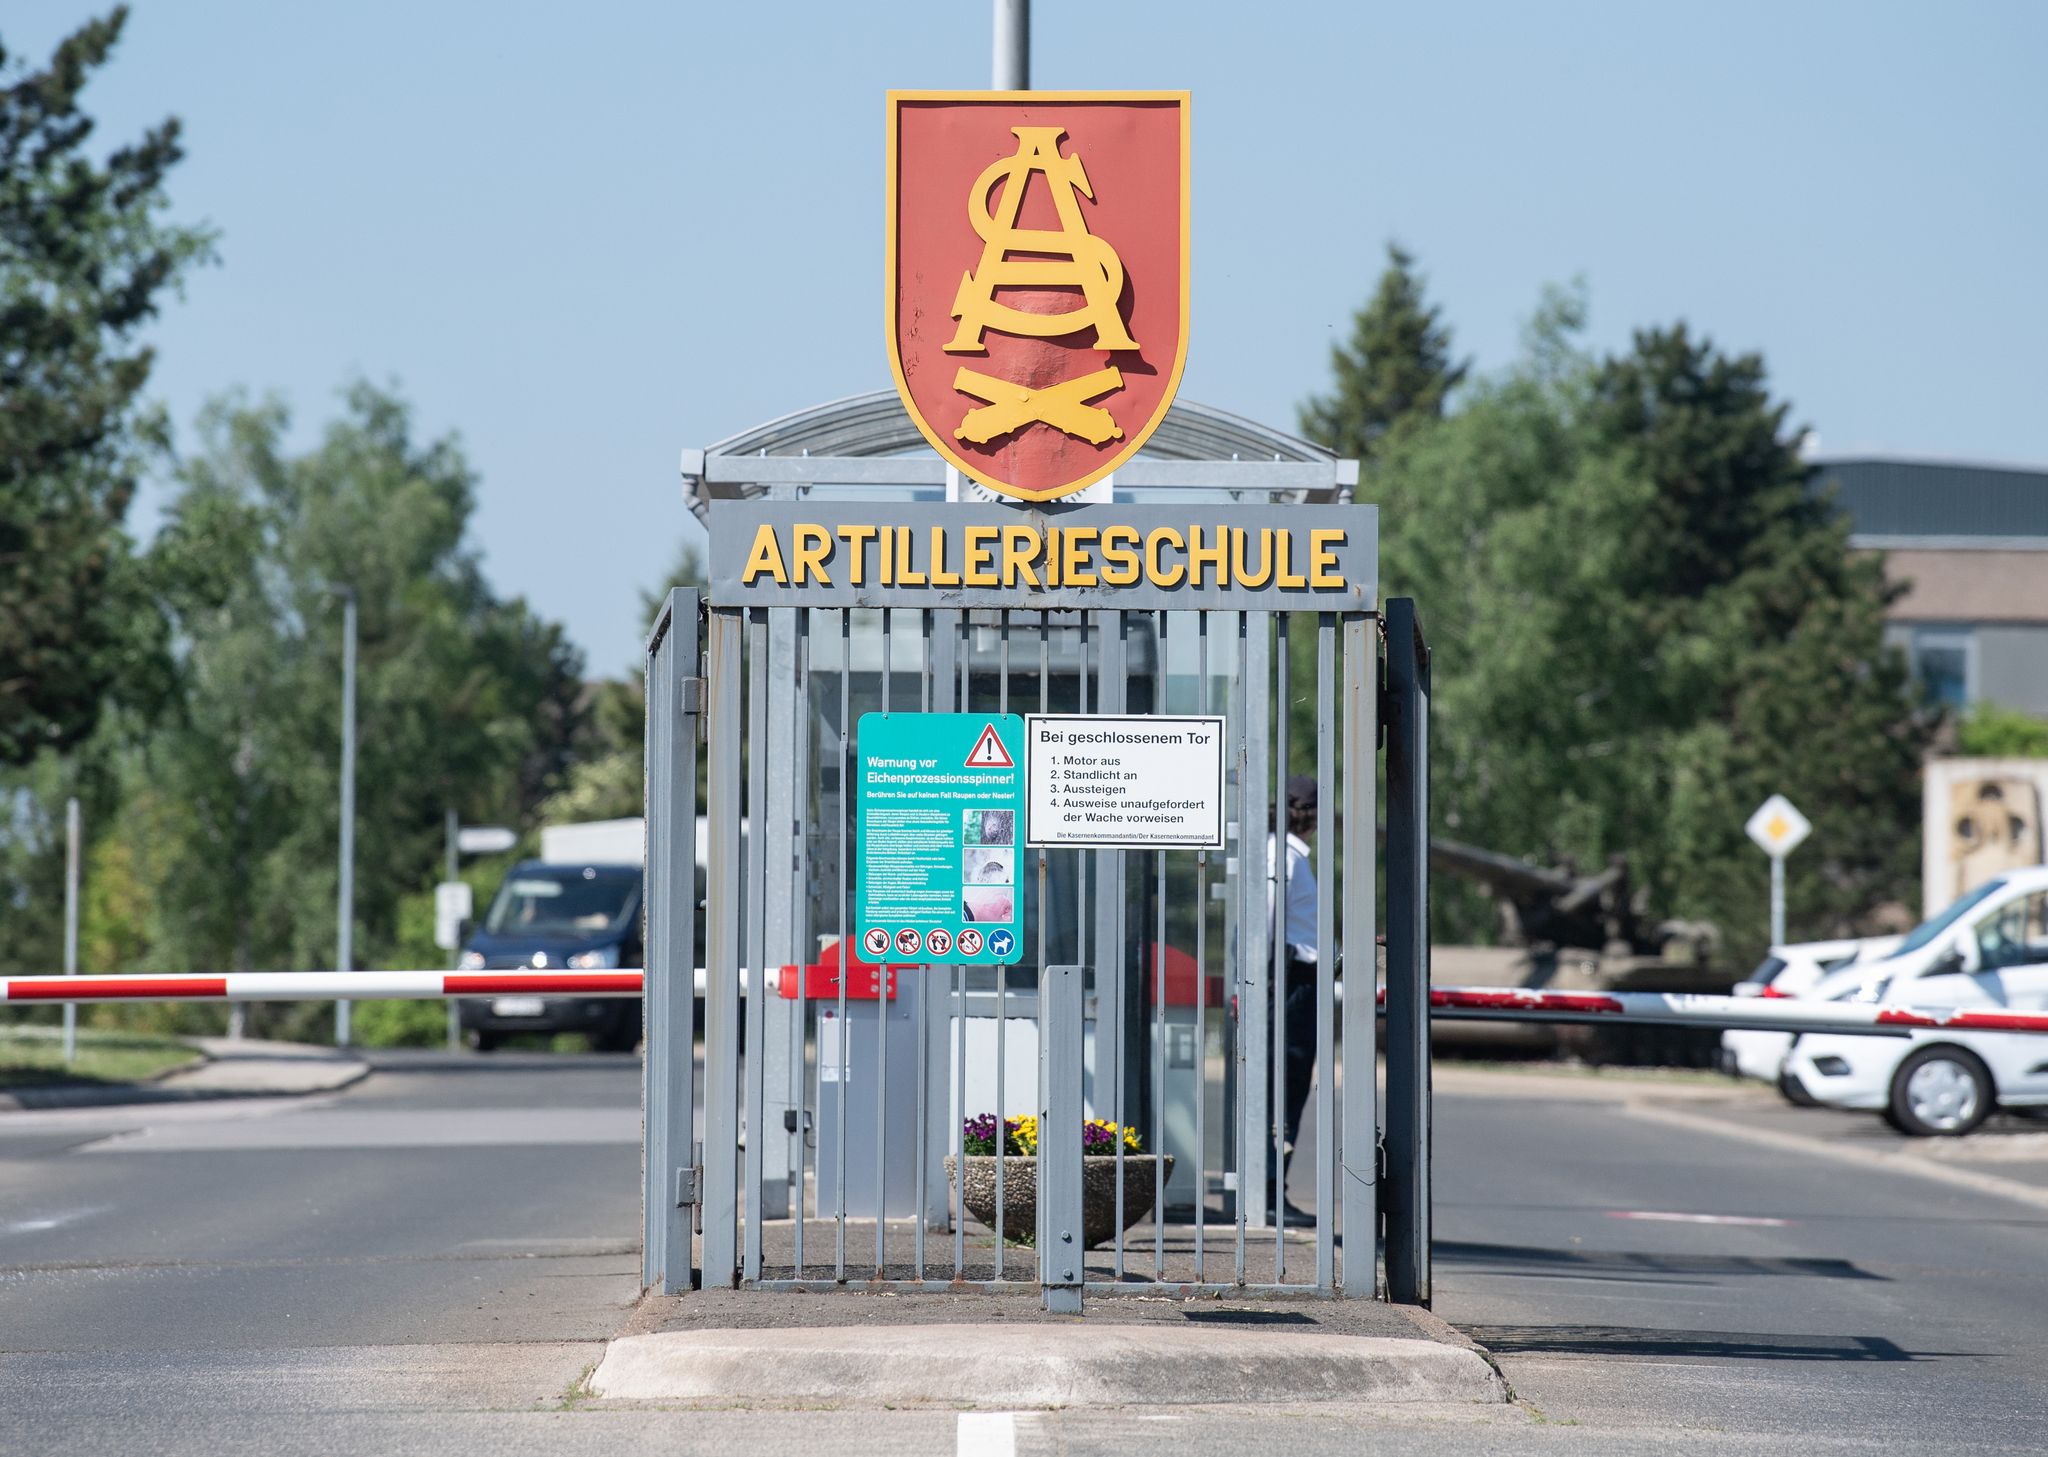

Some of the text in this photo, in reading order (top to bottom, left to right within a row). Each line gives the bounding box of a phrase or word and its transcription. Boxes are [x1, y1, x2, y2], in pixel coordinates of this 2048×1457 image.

[741, 523, 1346, 588] ARTILLERIESCHULE
[1041, 731, 1210, 745] Bei geschlossenem Tor
[867, 757, 937, 770] Warnung vor
[1051, 756, 1060, 765] 1.
[1064, 756, 1097, 765] Motor
[867, 773, 1015, 786] Eichenprozessionsspinner!
[1050, 770, 1060, 779] 2.
[1064, 770, 1120, 780] Standlicht
[1050, 785, 1126, 796] 3. Aussteigen
[1050, 799, 1204, 810] 4. Ausweise unaufgefordert
[1064, 813, 1184, 823] der Wache vorweisen
